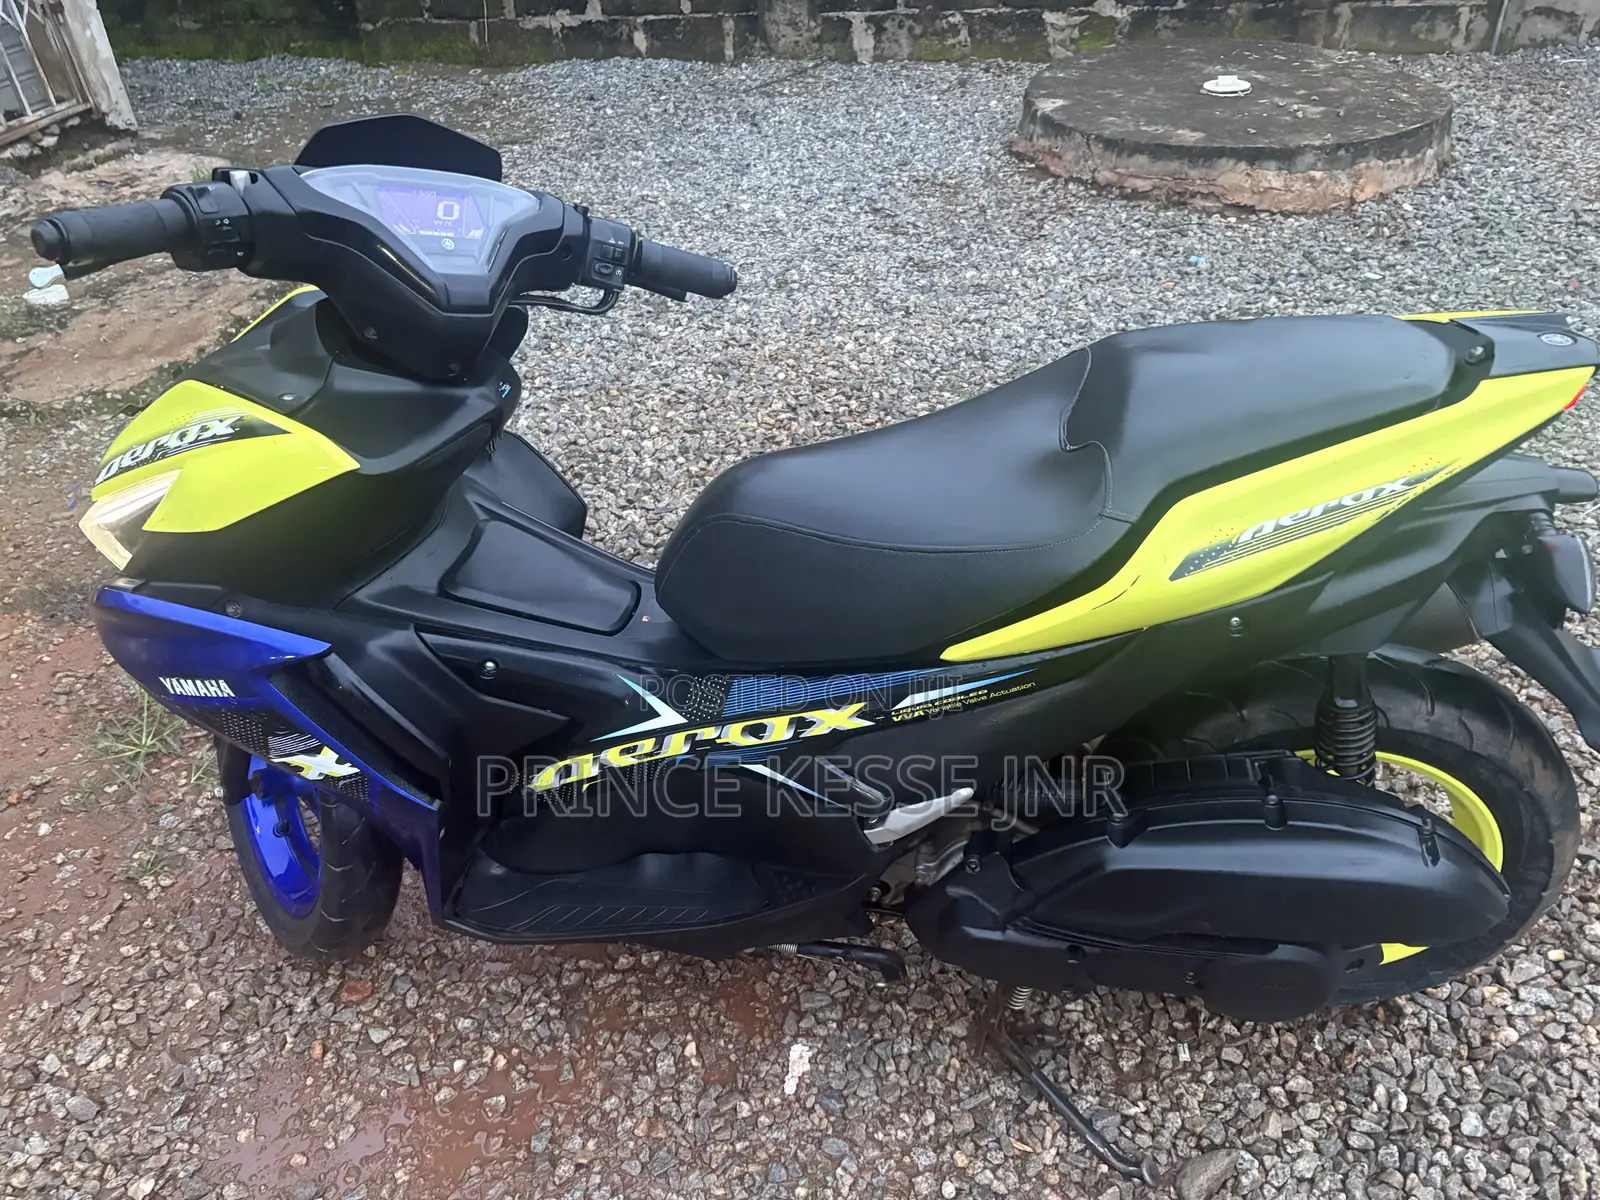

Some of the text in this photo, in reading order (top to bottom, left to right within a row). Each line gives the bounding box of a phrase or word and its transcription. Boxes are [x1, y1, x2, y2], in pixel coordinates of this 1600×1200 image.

[437, 201, 460, 220] 0
[159, 676, 235, 697] YAMAHA
[892, 682, 1036, 722] VVA Variable Valve Actuation
